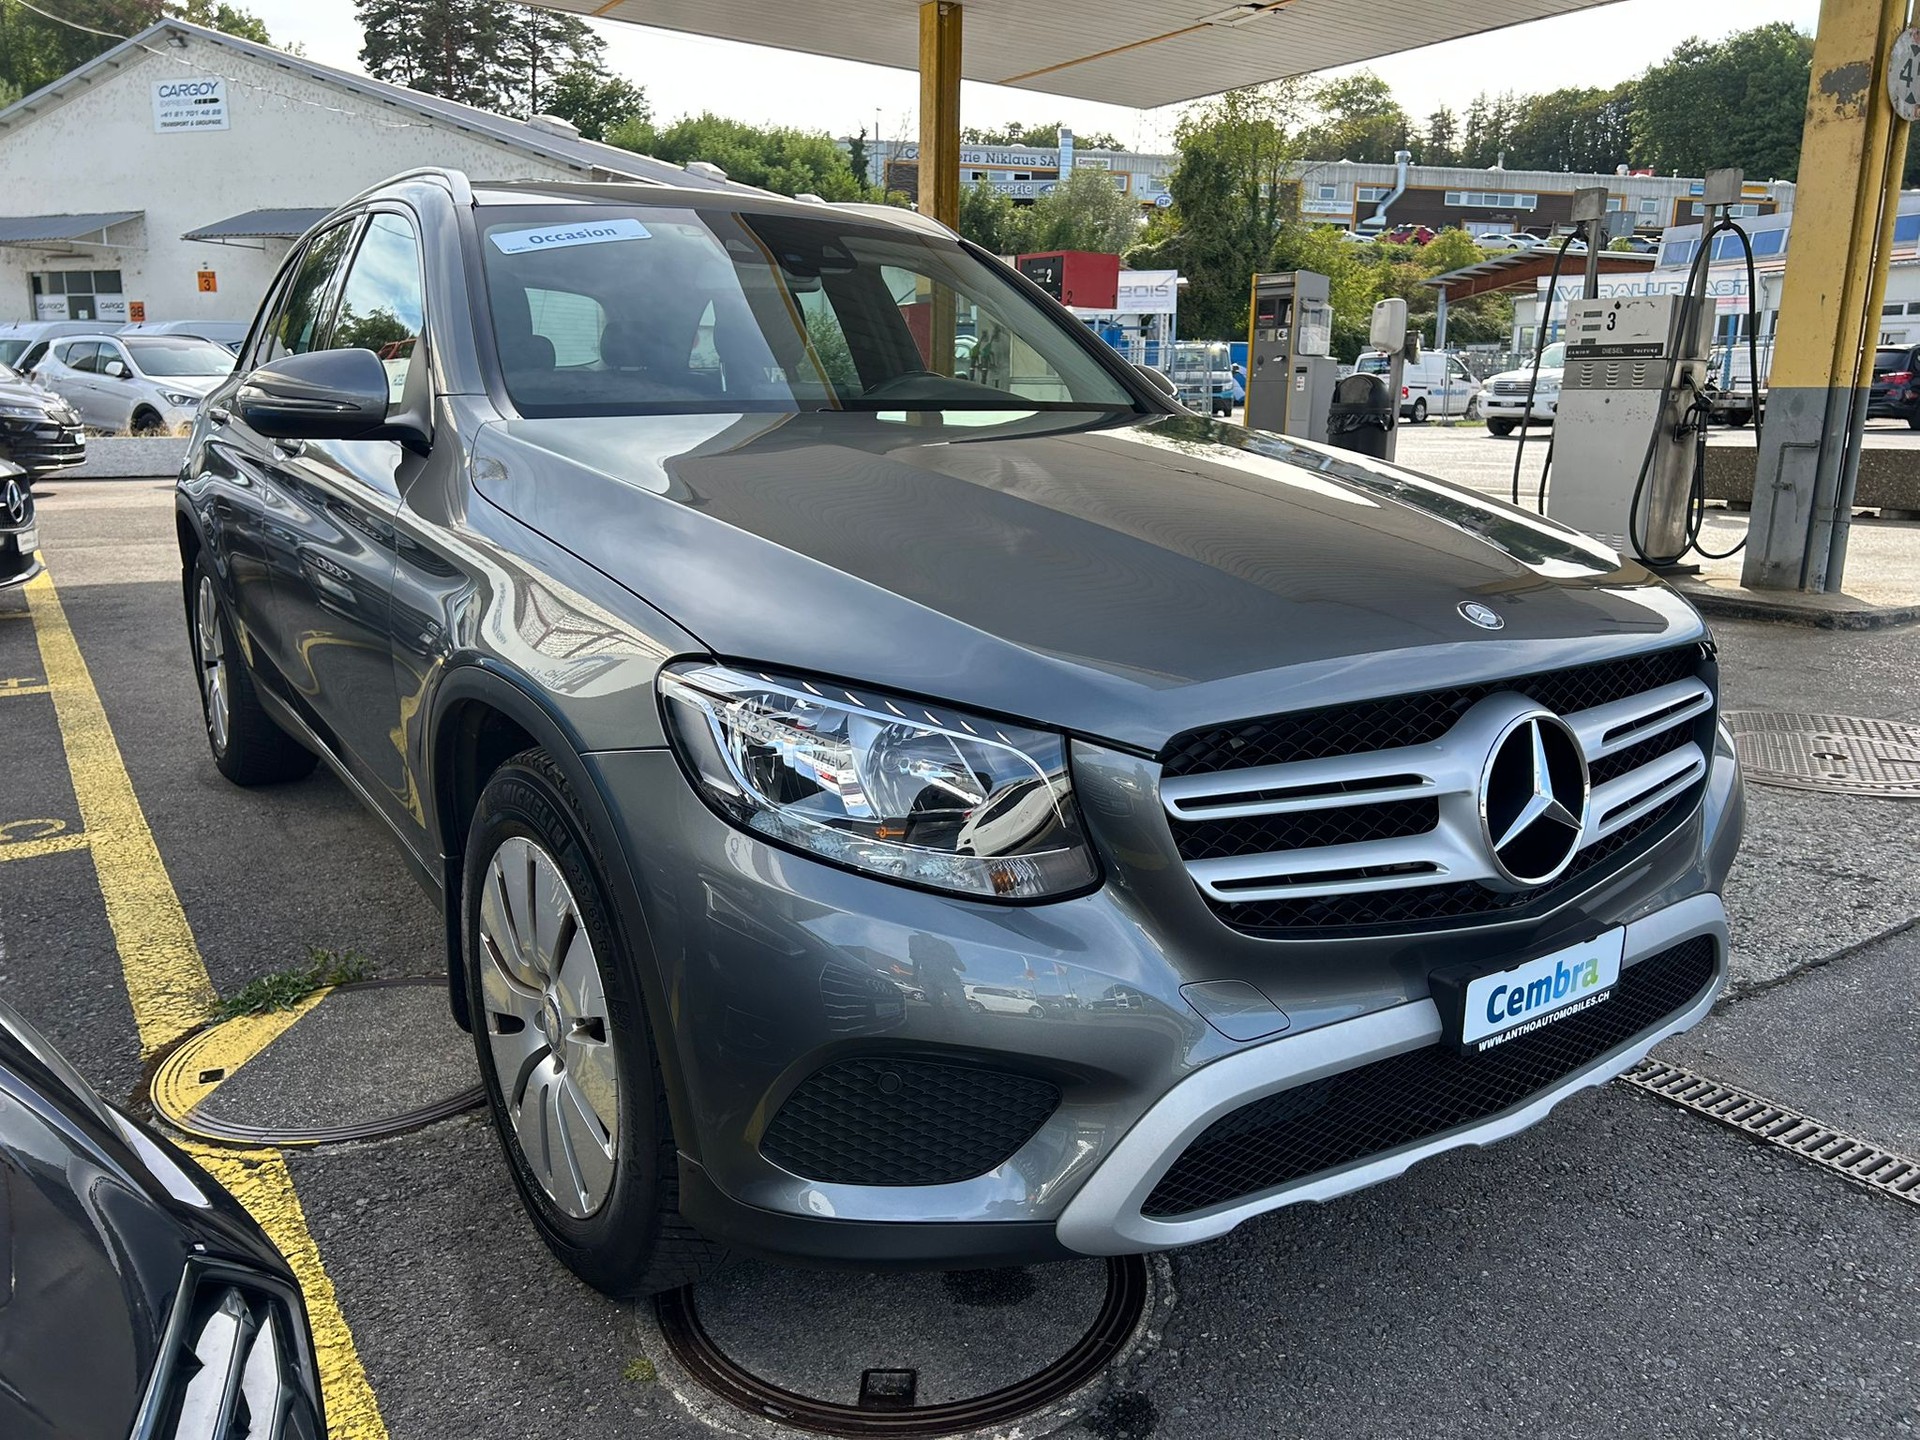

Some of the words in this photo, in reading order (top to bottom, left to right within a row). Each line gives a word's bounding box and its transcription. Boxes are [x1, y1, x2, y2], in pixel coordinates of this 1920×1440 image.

[1899, 58, 1920, 88] 4
[159, 81, 219, 98] CARGOY
[986, 153, 1036, 166] Niklaus
[1040, 156, 1057, 166] SA
[529, 227, 617, 244] Occasion
[1046, 269, 1052, 283] 2
[204, 279, 211, 291] 3
[1067, 291, 1073, 305] 2
[130, 306, 144, 318] 3B
[1607, 312, 1616, 331] 3
[502, 783, 567, 849] MICHELIN
[570, 864, 601, 932] 235/60
[1486, 958, 1599, 1024] Cembra
[1478, 990, 1610, 1052] WWW.ANTHOAUTOMOBILES.CH
